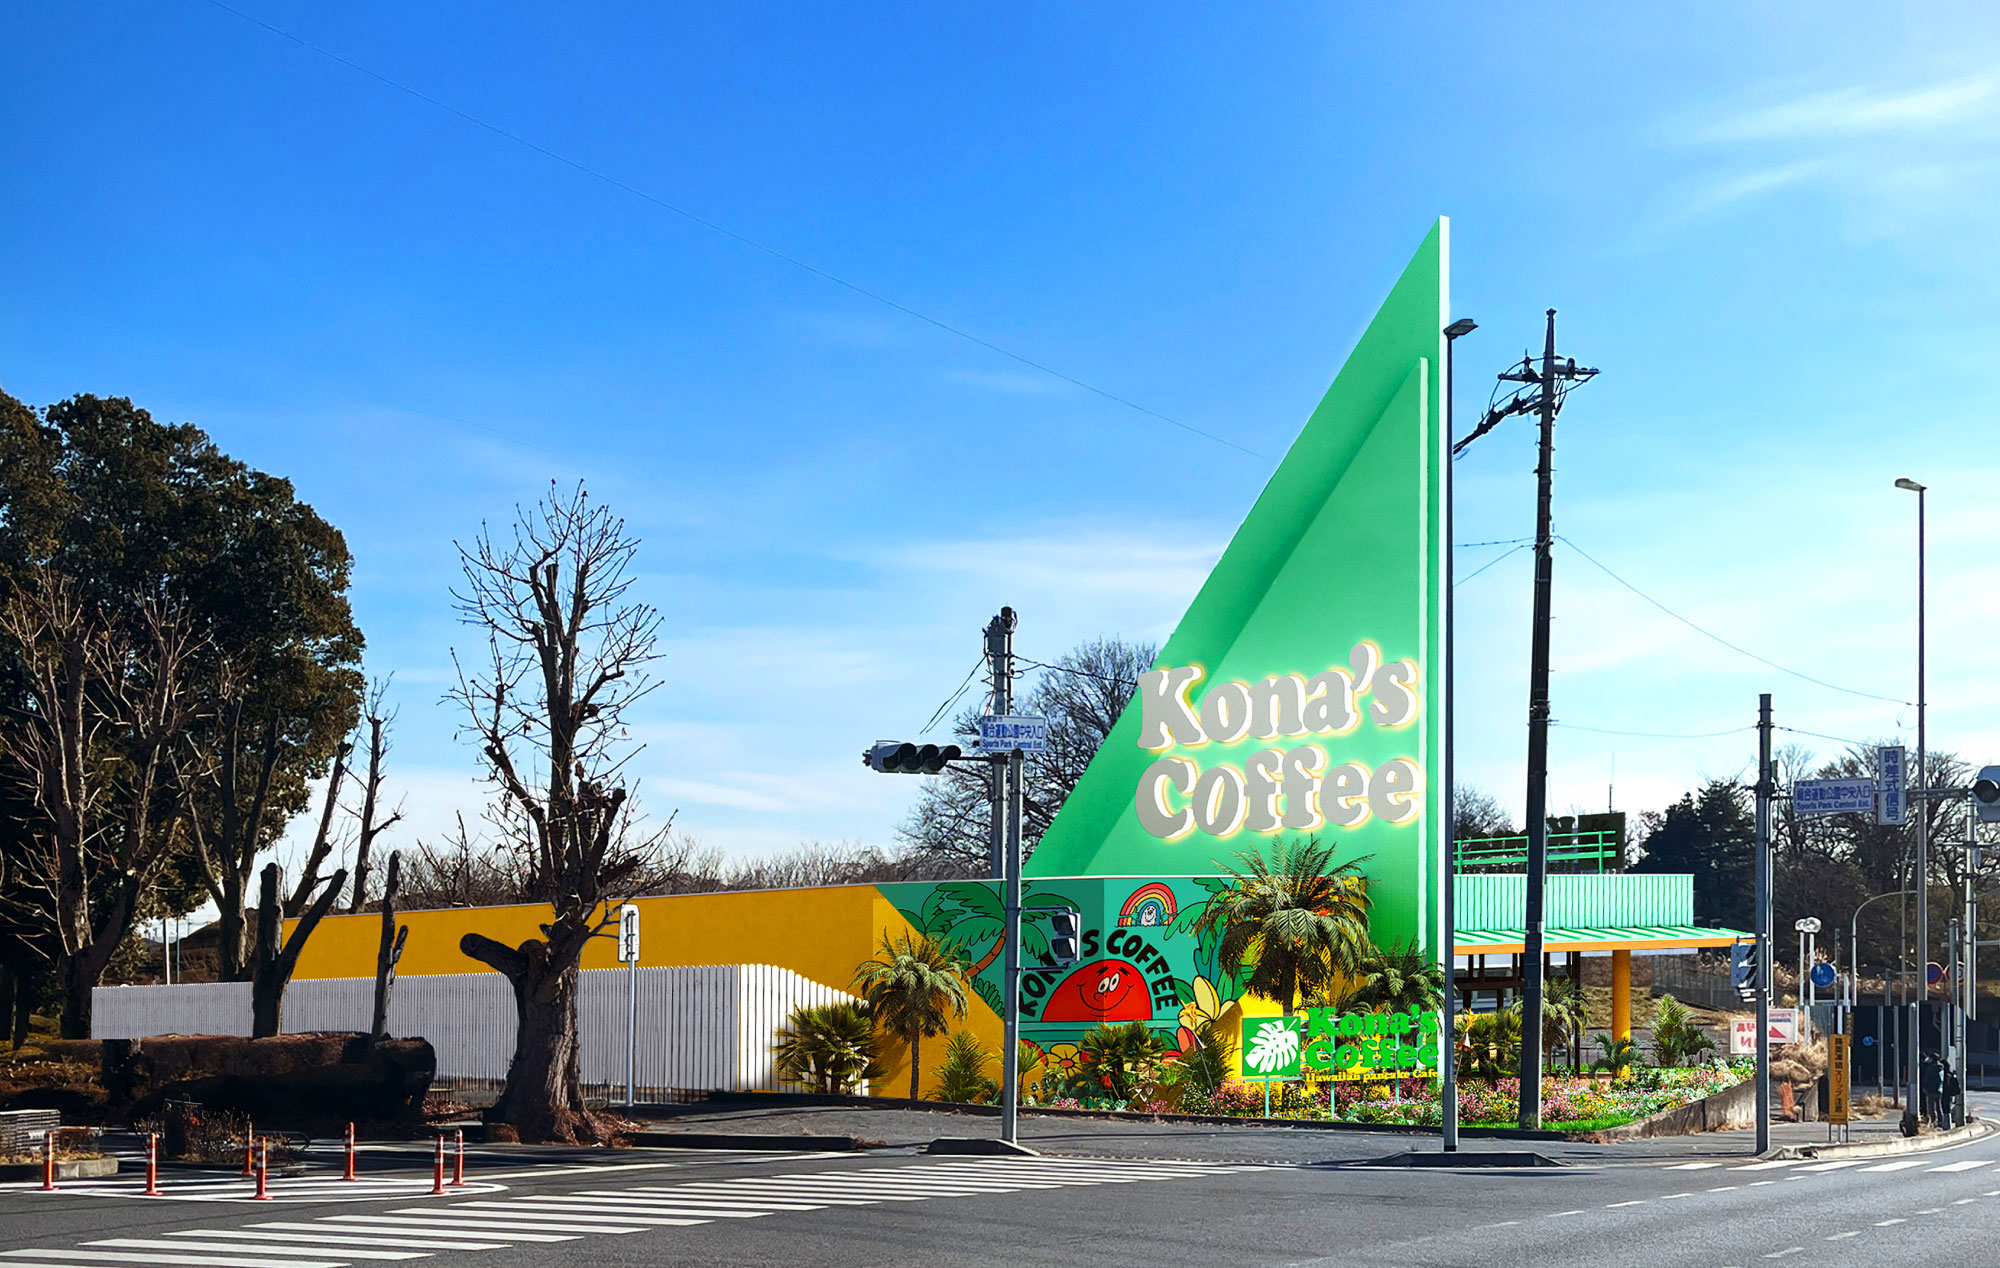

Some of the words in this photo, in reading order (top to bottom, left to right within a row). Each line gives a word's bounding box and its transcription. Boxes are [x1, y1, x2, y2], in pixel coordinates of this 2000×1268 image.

[1137, 642, 1418, 749] Kona's
[1001, 740, 1011, 748] Park
[1135, 746, 1420, 838] Coffee
[1884, 750, 1899, 820] 時差式信号
[1018, 929, 1100, 1017] KONS
[1106, 929, 1178, 1010] COFFEE
[1307, 1004, 1438, 1037] Kona's
[1305, 1038, 1439, 1071] Coffee
[1306, 1072, 1361, 1082] Hawaiian
[1363, 1070, 1410, 1082] pancake
